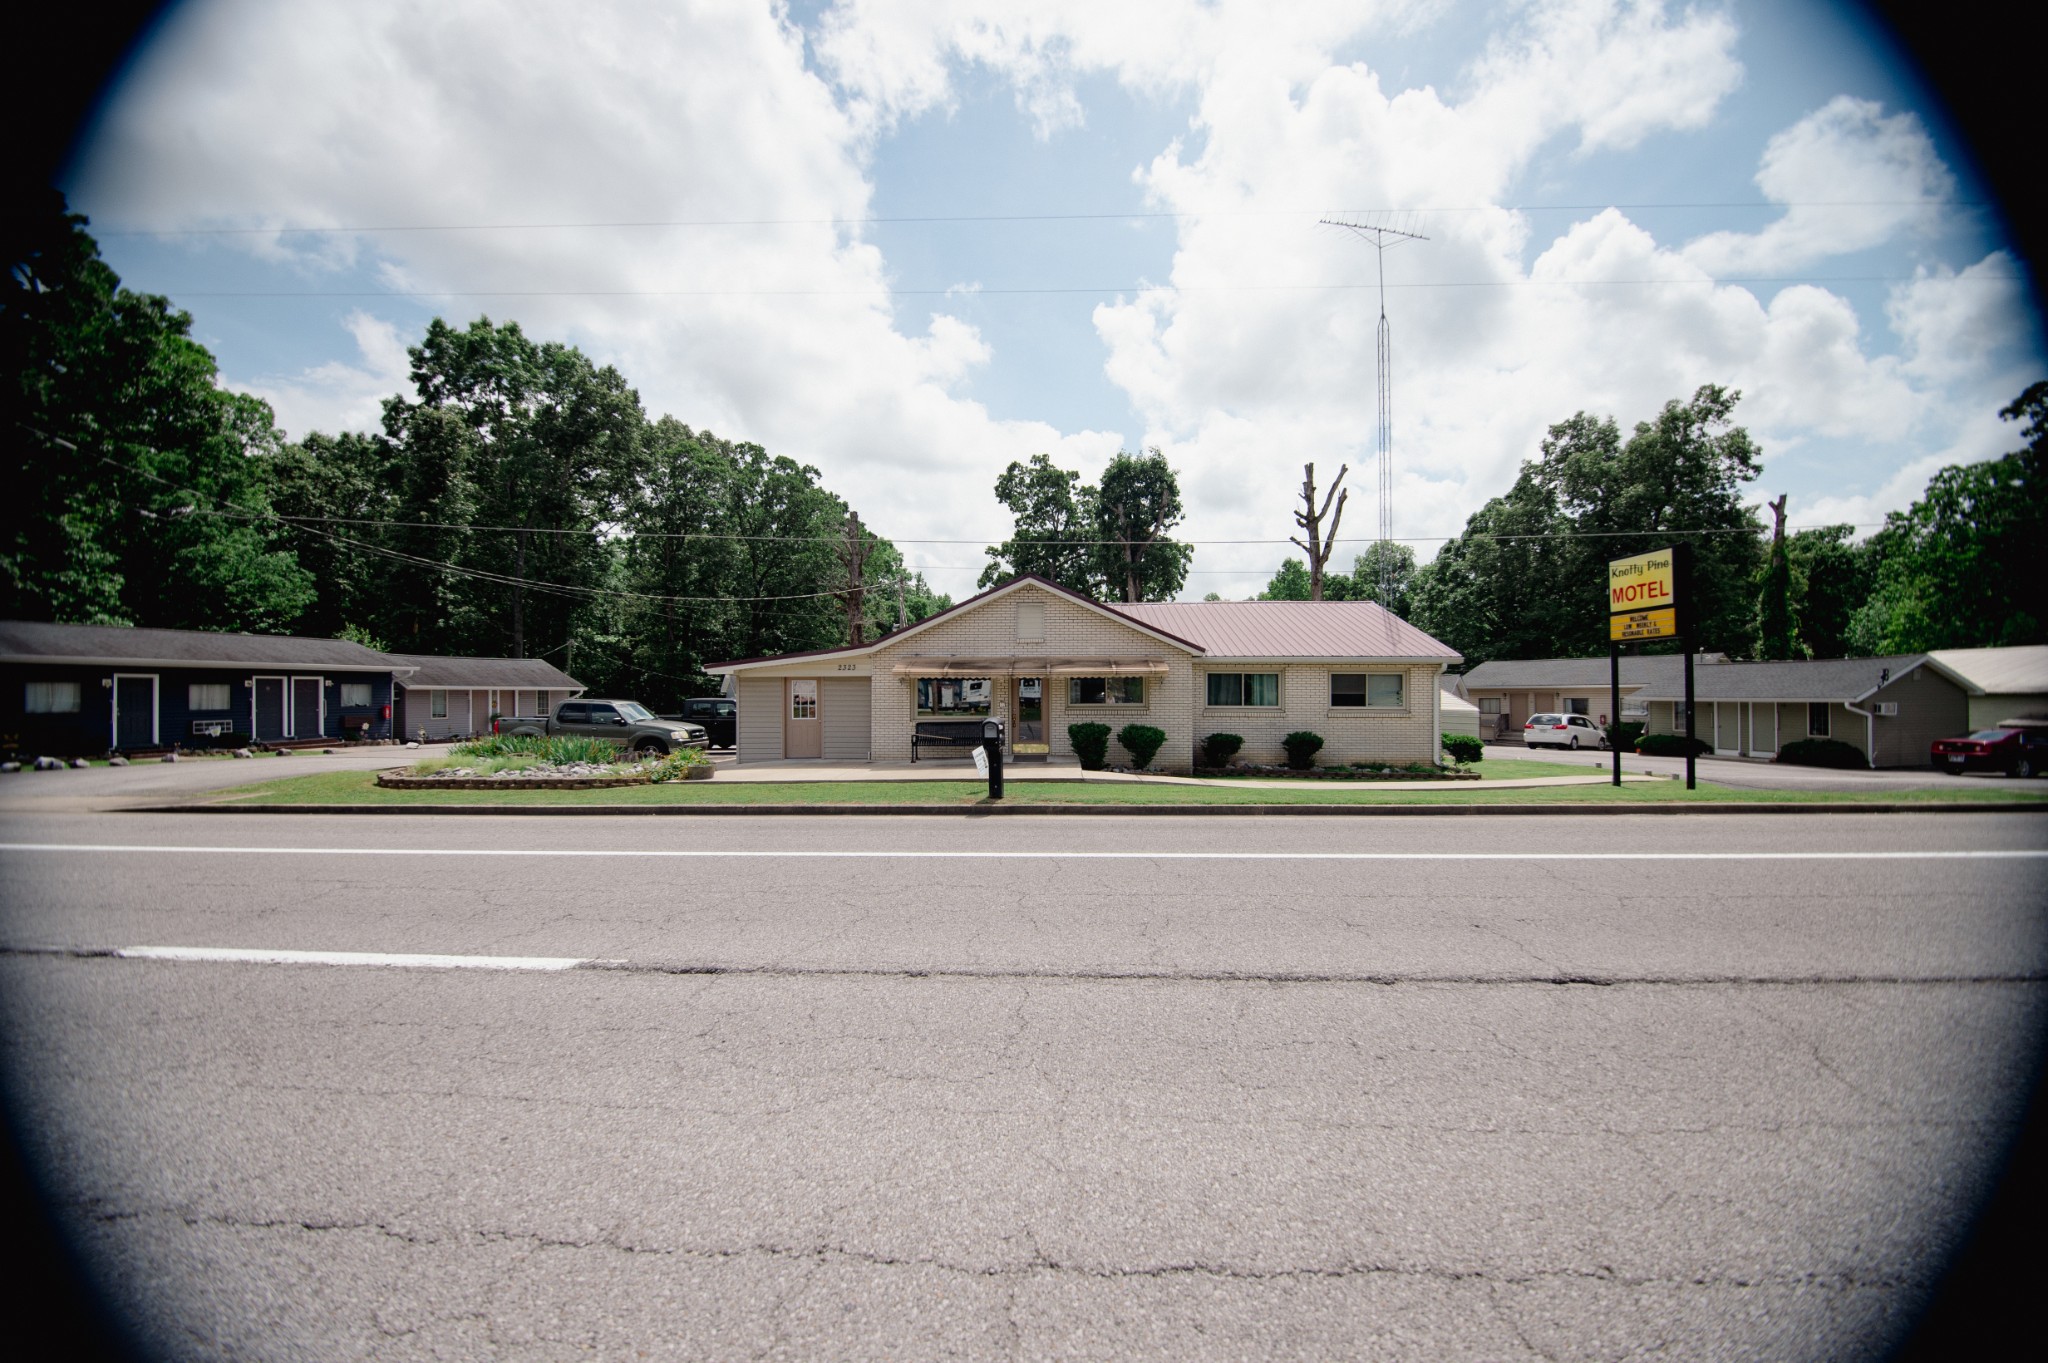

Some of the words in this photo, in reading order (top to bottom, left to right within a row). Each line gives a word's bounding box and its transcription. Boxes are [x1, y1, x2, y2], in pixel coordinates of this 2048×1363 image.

[1612, 564, 1643, 578] Knotty
[1647, 560, 1669, 571] Pine
[1612, 580, 1669, 604] MOTEL
[1629, 614, 1648, 622] WELCOME
[1636, 621, 1652, 629] WEEKLY
